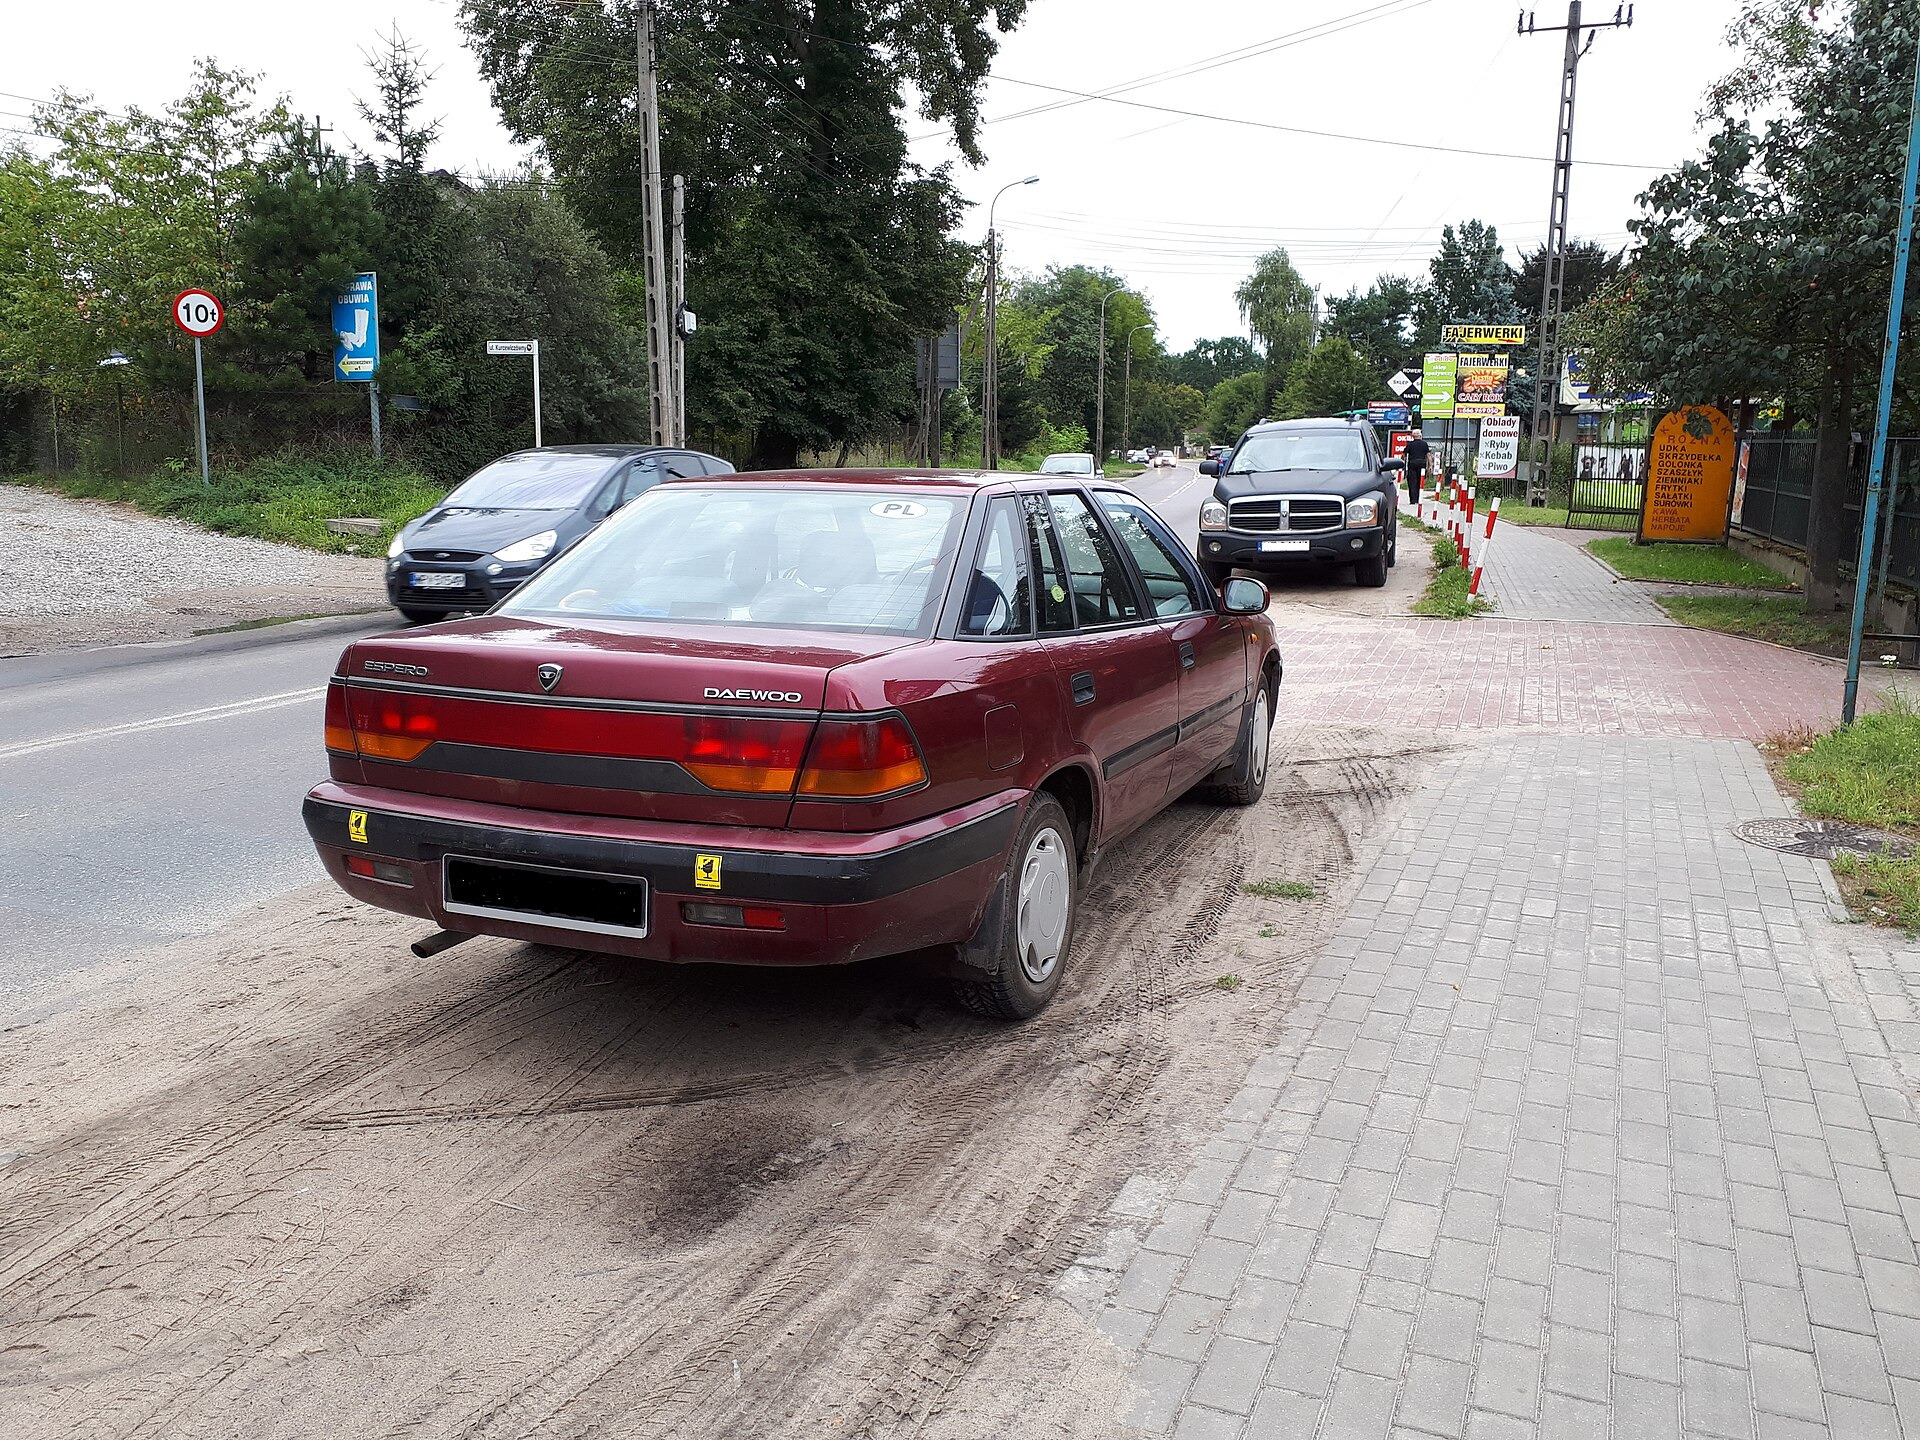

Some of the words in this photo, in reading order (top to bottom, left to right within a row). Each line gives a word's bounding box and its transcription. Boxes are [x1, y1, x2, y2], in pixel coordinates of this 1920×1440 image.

[337, 293, 370, 305] OBUWIA
[182, 302, 217, 323] 10t
[1445, 327, 1523, 339] FAJERWERKI
[1459, 357, 1508, 367] FAJERWERKI
[1482, 429, 1519, 438] domowe
[1490, 440, 1510, 451] Ryby
[1659, 445, 1687, 453] UDKA
[1485, 451, 1513, 460] Kebab
[1658, 452, 1722, 462] SKRZYDEŁKA
[1488, 461, 1508, 471] Piwo
[1658, 460, 1703, 469] GOLONKA
[1657, 468, 1704, 477] SZASZŁYK
[1656, 476, 1703, 485] ZIEMNIAKI
[1655, 484, 1688, 493] FRYTKI
[1654, 492, 1693, 501] SAŁATKI
[1653, 499, 1693, 508] SURÓWKI
[882, 503, 915, 516] PL
[1652, 507, 1678, 516] KAWA
[1651, 516, 1691, 525] HERBATA
[1650, 524, 1686, 532] NAPOJE
[364, 660, 429, 677] ESPERO
[703, 687, 803, 704] DAEWOO
